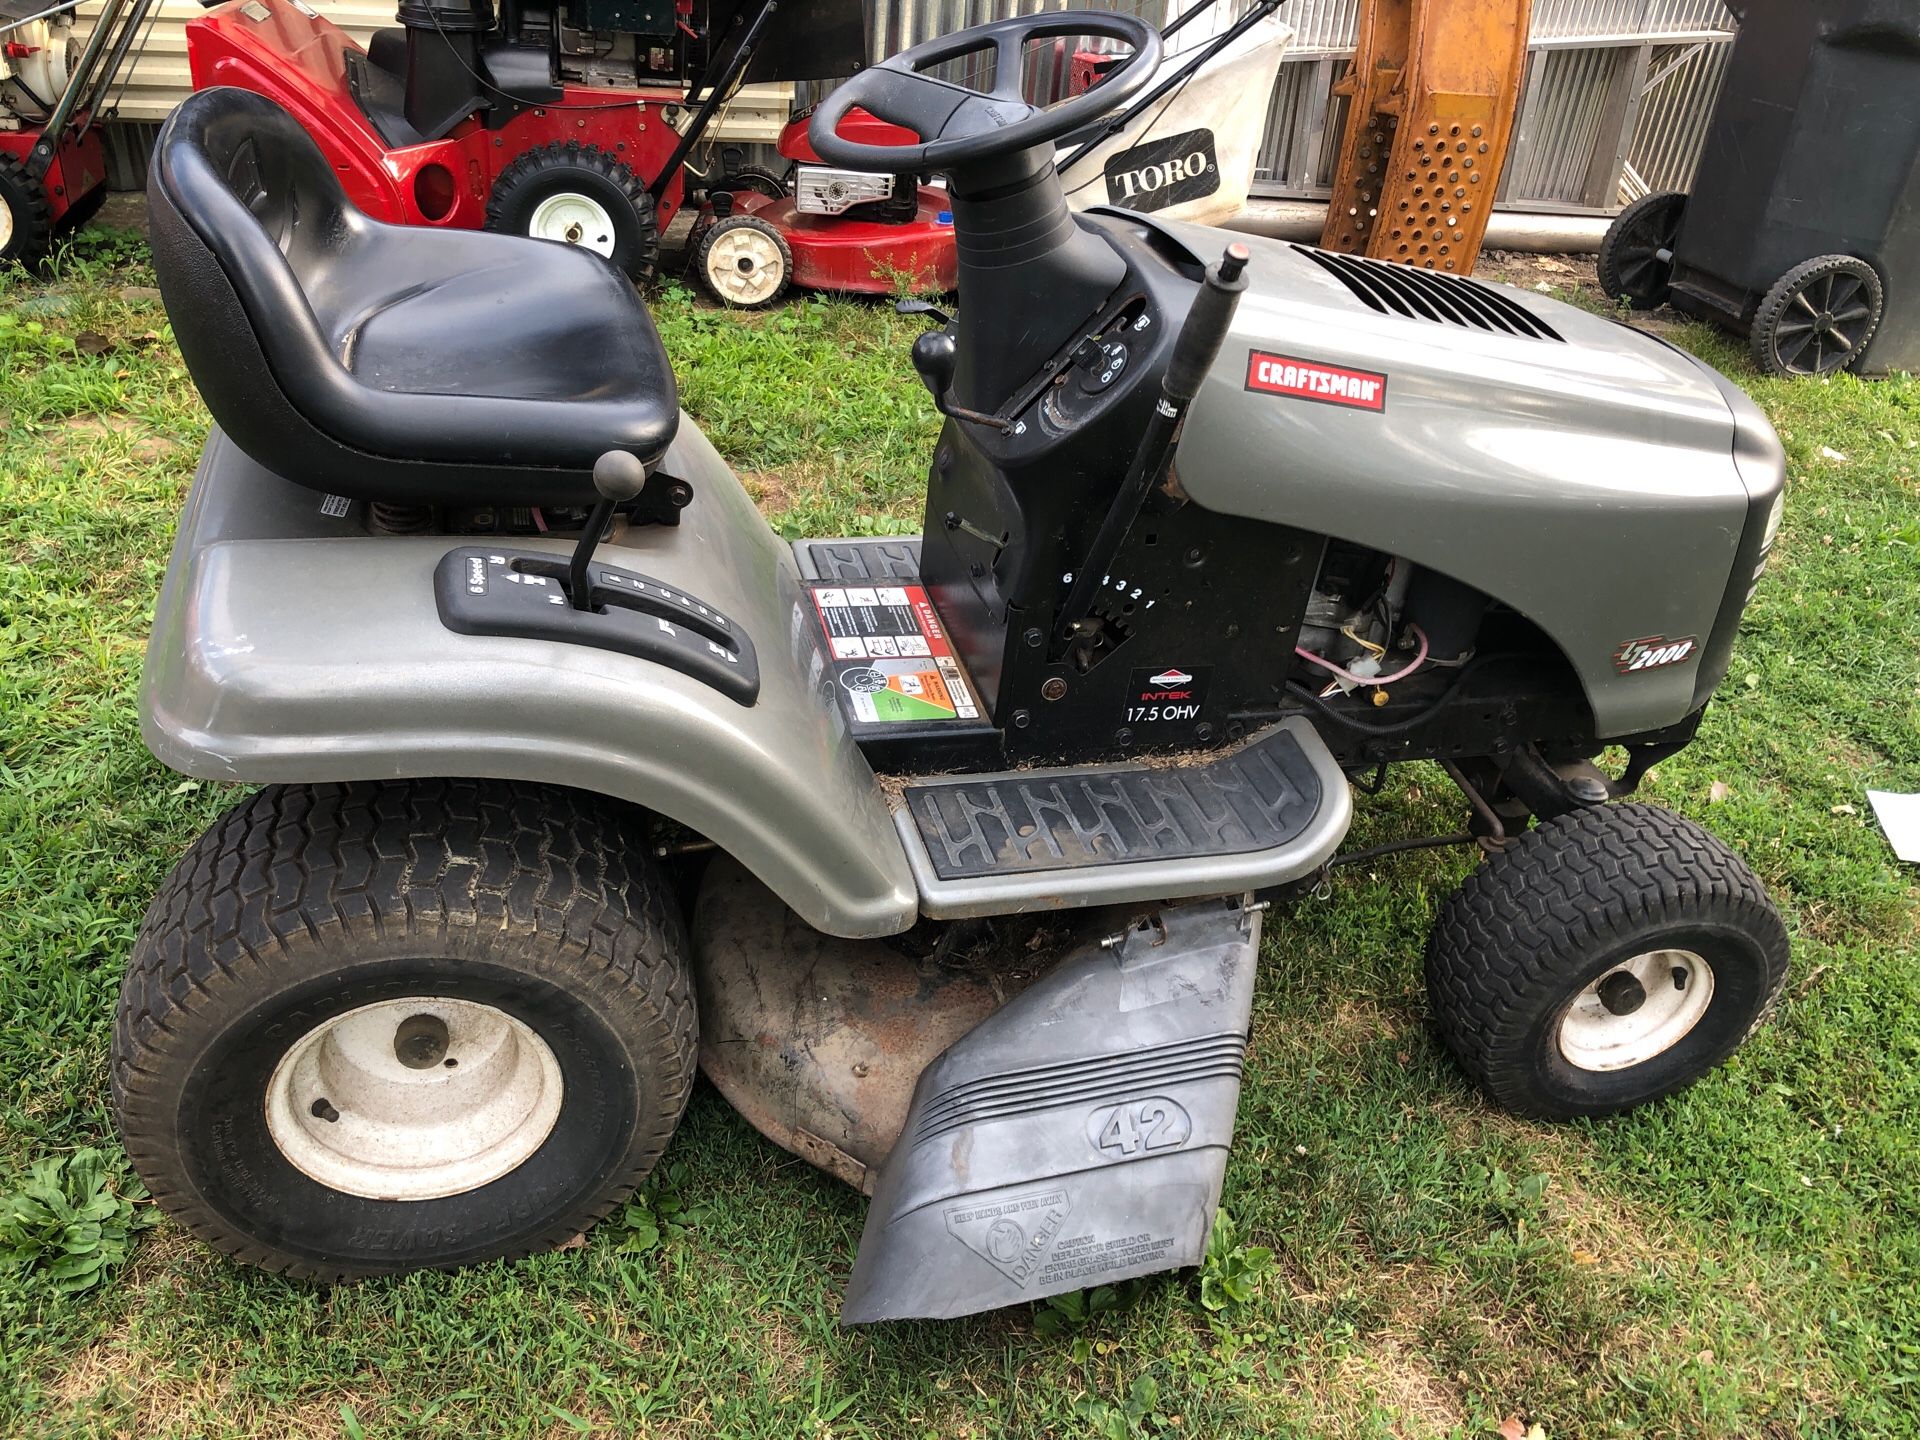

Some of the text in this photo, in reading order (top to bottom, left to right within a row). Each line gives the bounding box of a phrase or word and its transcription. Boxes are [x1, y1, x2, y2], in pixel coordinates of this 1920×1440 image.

[1115, 152, 1207, 199] TORO
[1257, 361, 1375, 402] CRAFTSMAN
[469, 556, 487, 593] 6 Speed
[489, 555, 506, 565] R
[548, 594, 564, 606] N
[609, 574, 725, 625] 1 2 3 4 5 6
[1062, 572, 1073, 584] 6
[1115, 580, 1127, 591] 3
[1130, 588, 1143, 600] 2
[1145, 600, 1156, 609] 1
[922, 609, 943, 640] DANGER
[1126, 704, 1201, 722] 17.5 OHV
[1141, 690, 1193, 702] INTEK
[1100, 1104, 1185, 1156] 42
[1012, 1208, 1063, 1281] DANGER
